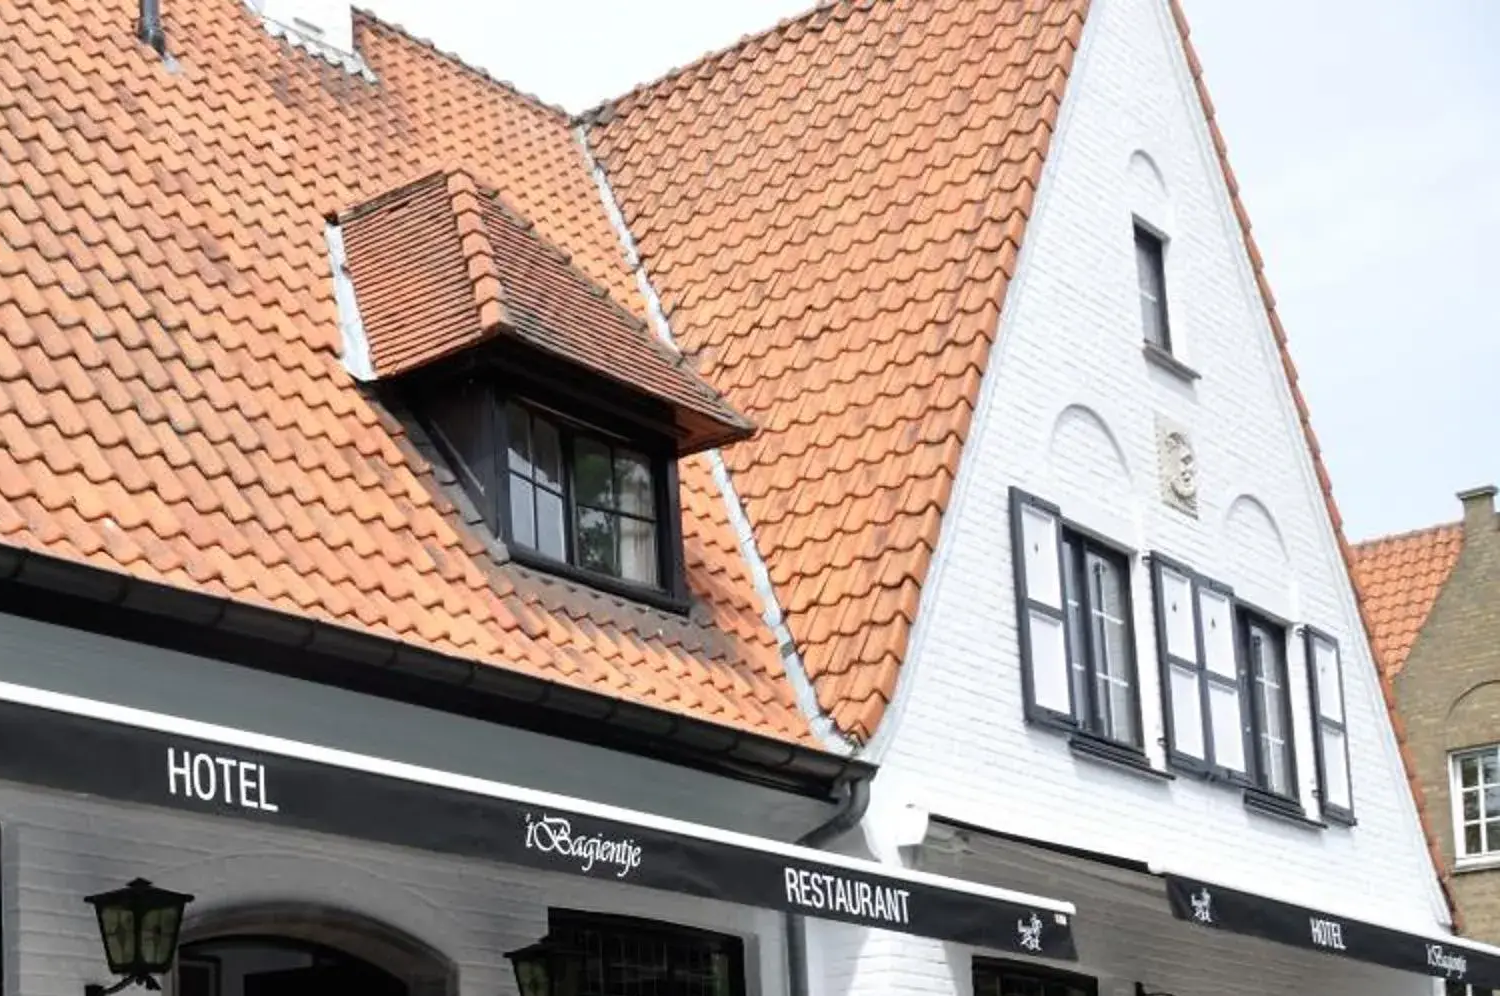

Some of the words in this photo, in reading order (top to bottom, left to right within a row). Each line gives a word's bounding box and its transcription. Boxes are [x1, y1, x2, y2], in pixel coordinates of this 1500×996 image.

[167, 747, 279, 812] HOTEL
[784, 867, 910, 924] RESTAURANT
[1309, 917, 1347, 950] HOTEL
